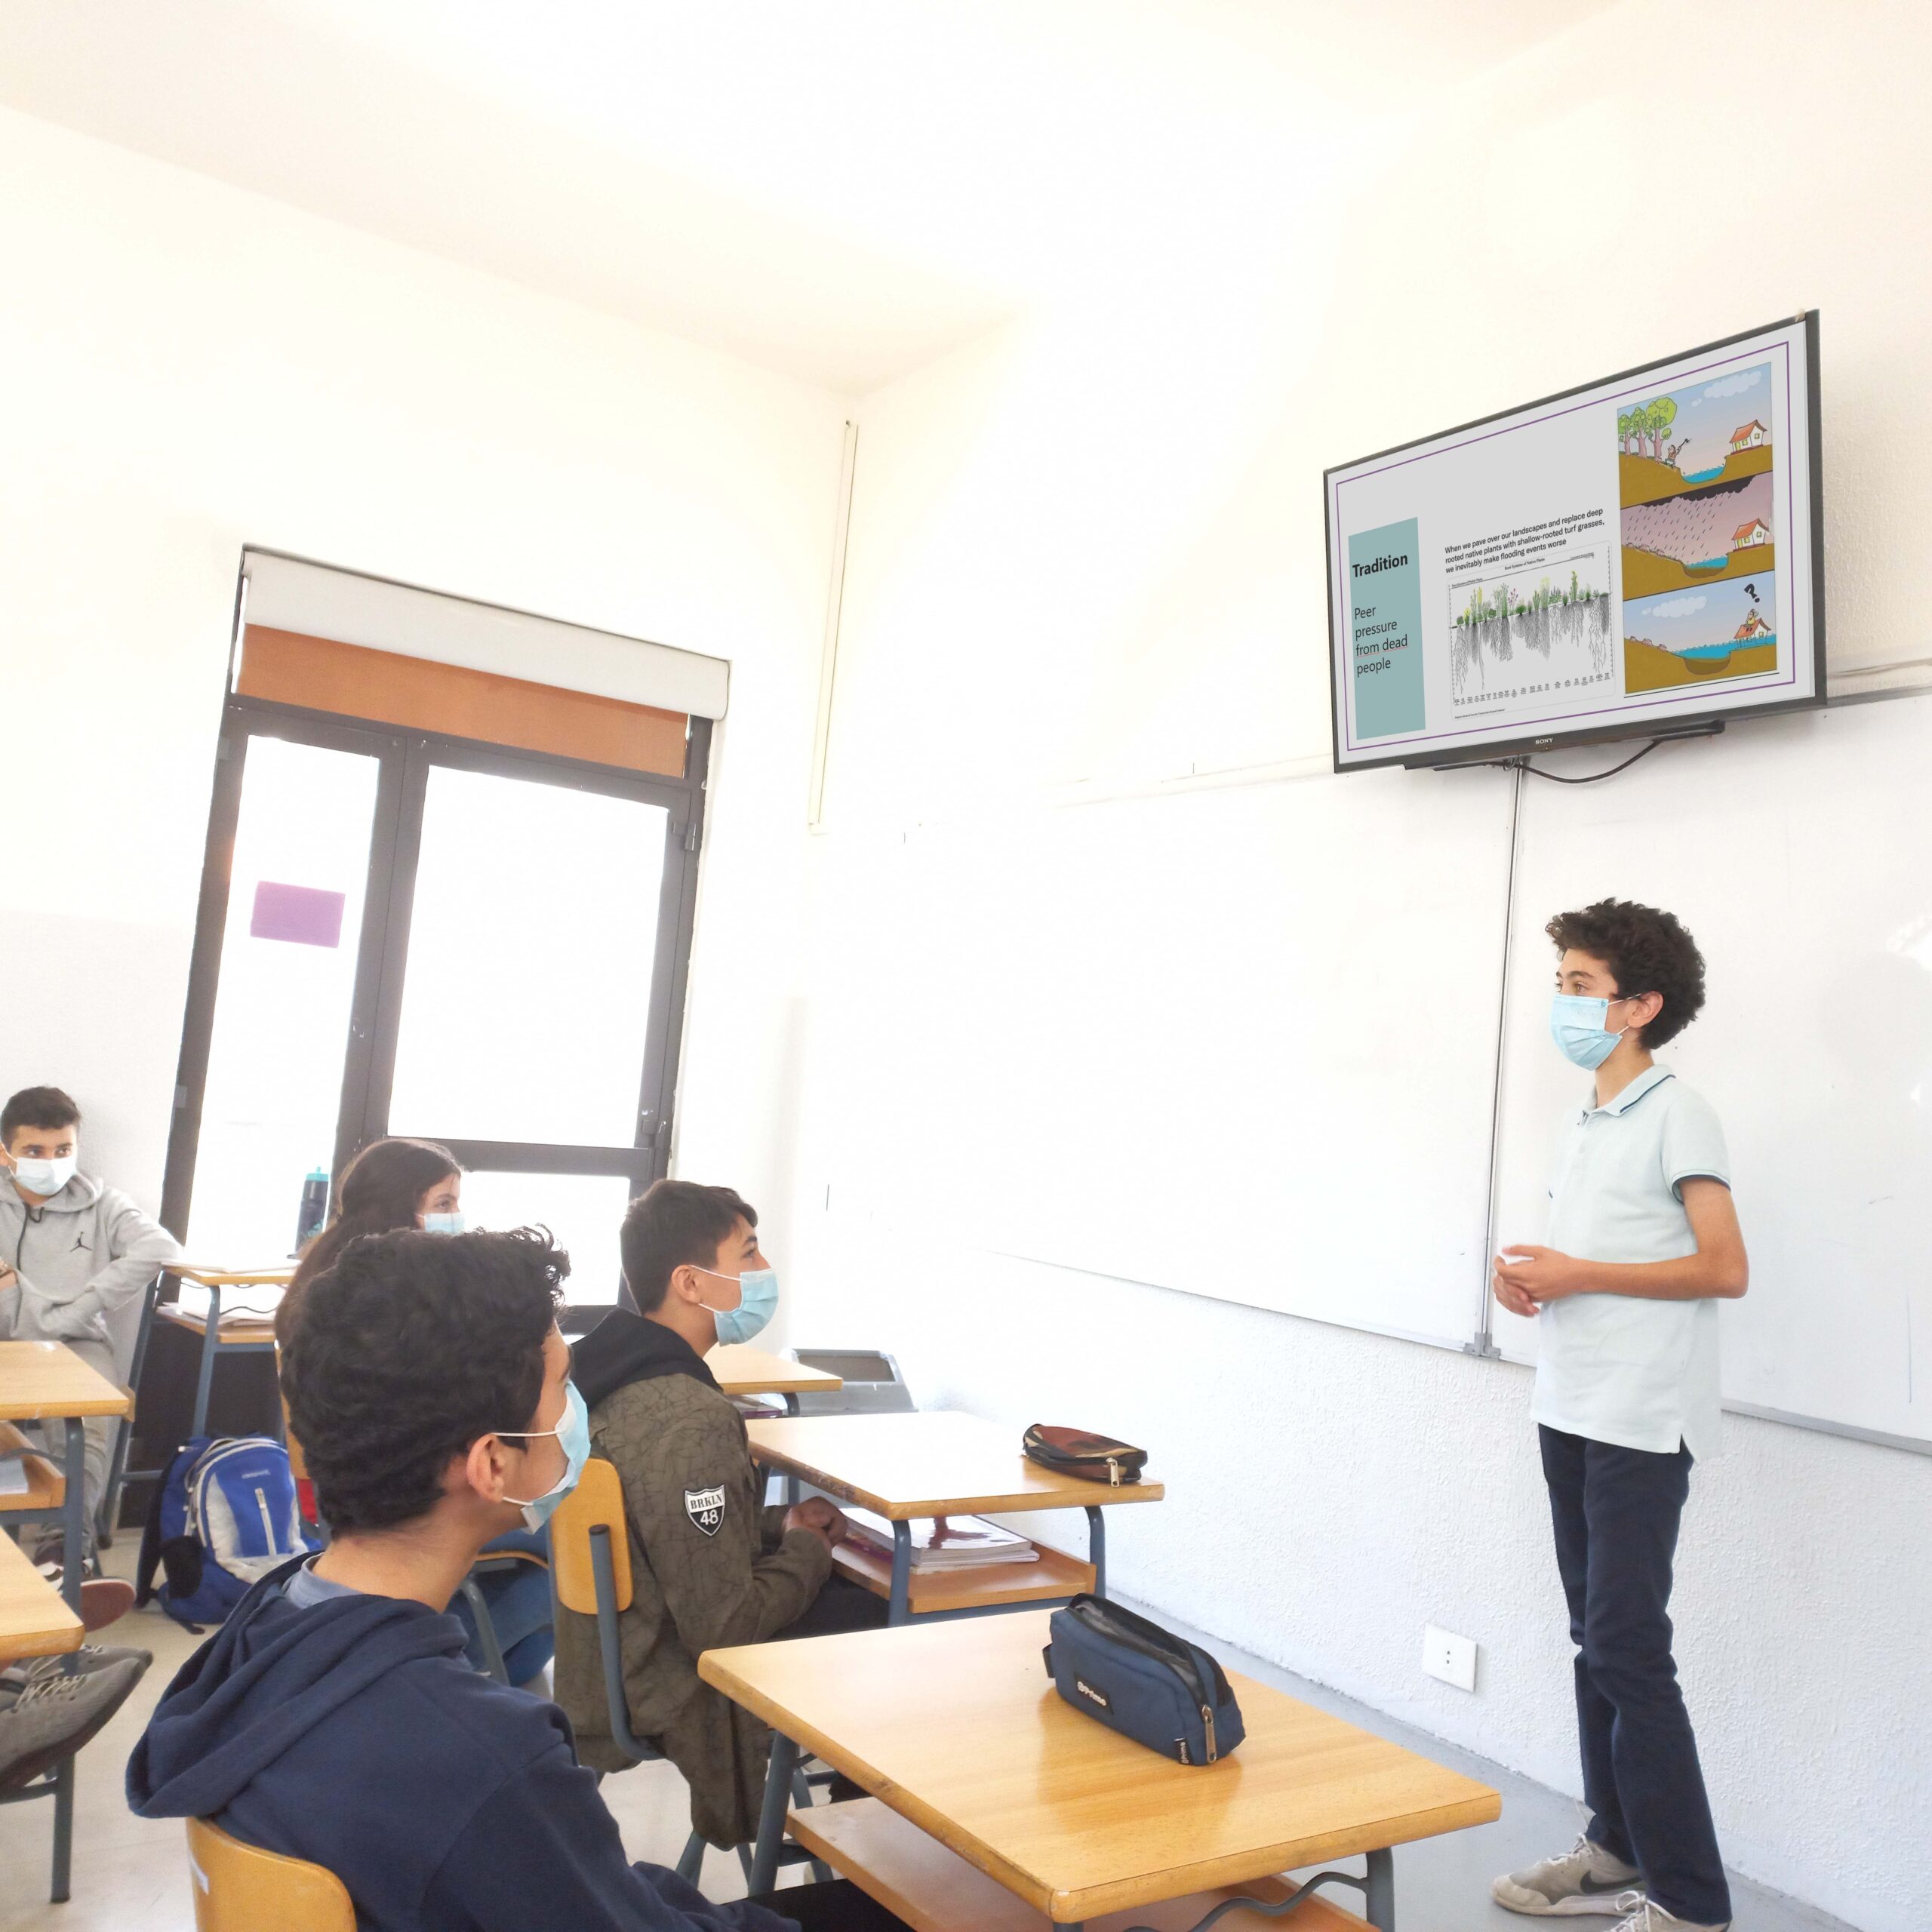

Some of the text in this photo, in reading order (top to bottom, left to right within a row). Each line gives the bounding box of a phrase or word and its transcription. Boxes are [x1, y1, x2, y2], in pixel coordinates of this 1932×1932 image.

[1444, 544, 1462, 554] When
[1472, 538, 1487, 549] pave
[1487, 534, 1500, 543] over
[1512, 522, 1547, 537] landscapes
[1549, 518, 1561, 528] and
[1561, 512, 1586, 525] replace
[1586, 508, 1604, 521] deep
[1445, 518, 1605, 564] rooted native plants with shallow-rooted turf grasses,
[1352, 555, 1408, 578] Tradition
[1455, 558, 1483, 572] inevitably
[1483, 555, 1500, 565] make
[1500, 548, 1525, 561] flooding
[1526, 543, 1547, 555] events
[1547, 538, 1567, 549] worse
[1355, 606, 1376, 620] Peer
[1355, 621, 1398, 641] pressure
[1356, 634, 1408, 657] from dead
[1357, 657, 1392, 678] people
[700, 1509, 718, 1525] 48
